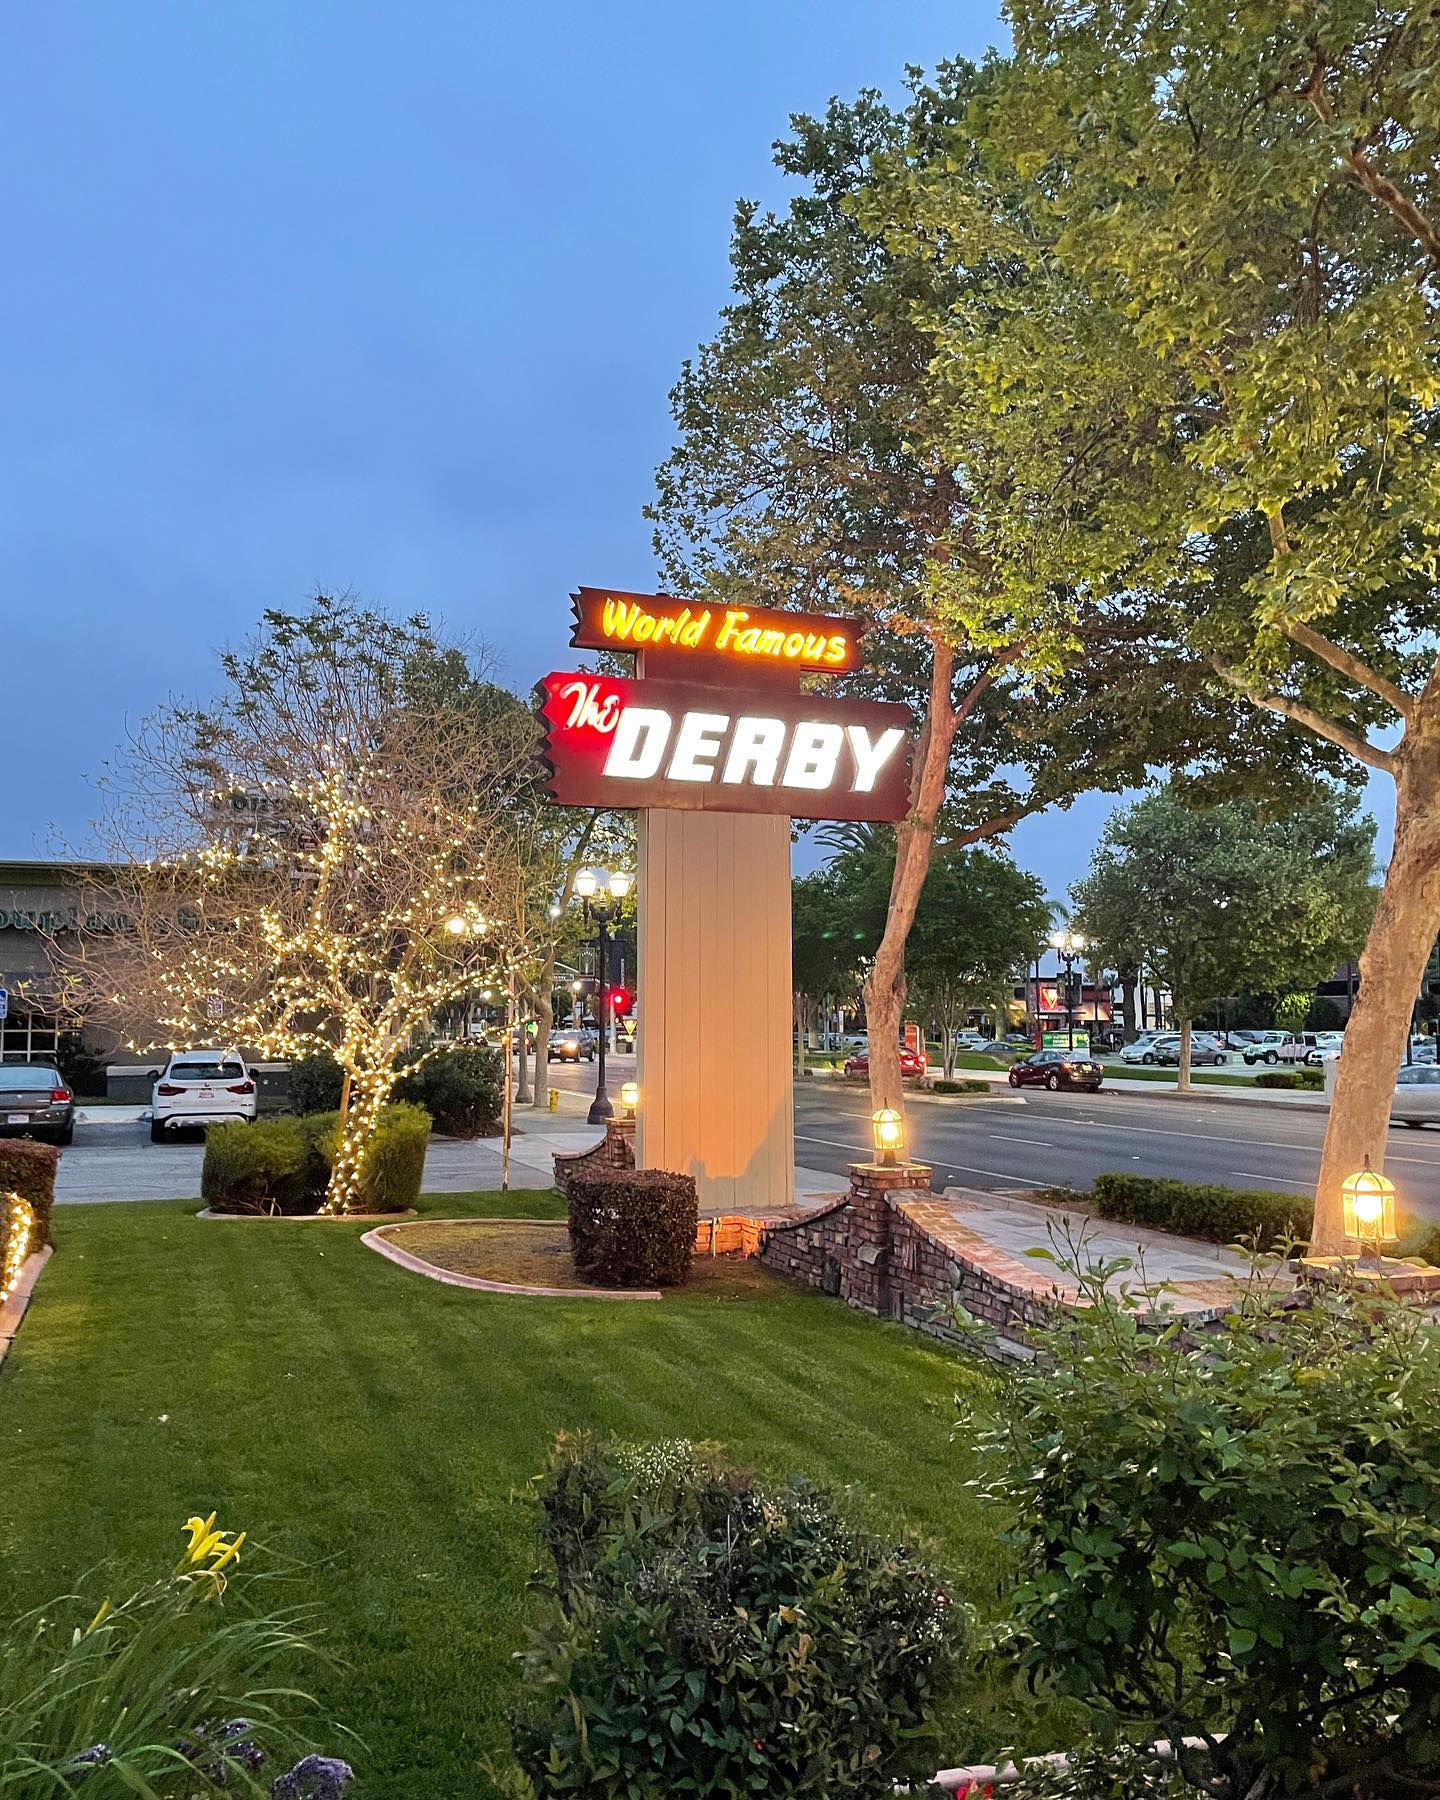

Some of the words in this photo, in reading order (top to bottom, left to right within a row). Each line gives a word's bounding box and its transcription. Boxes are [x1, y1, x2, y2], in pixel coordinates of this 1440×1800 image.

[602, 596, 711, 649] World
[714, 609, 848, 662] Famous
[560, 681, 622, 734] The
[602, 706, 906, 793] DERBY
